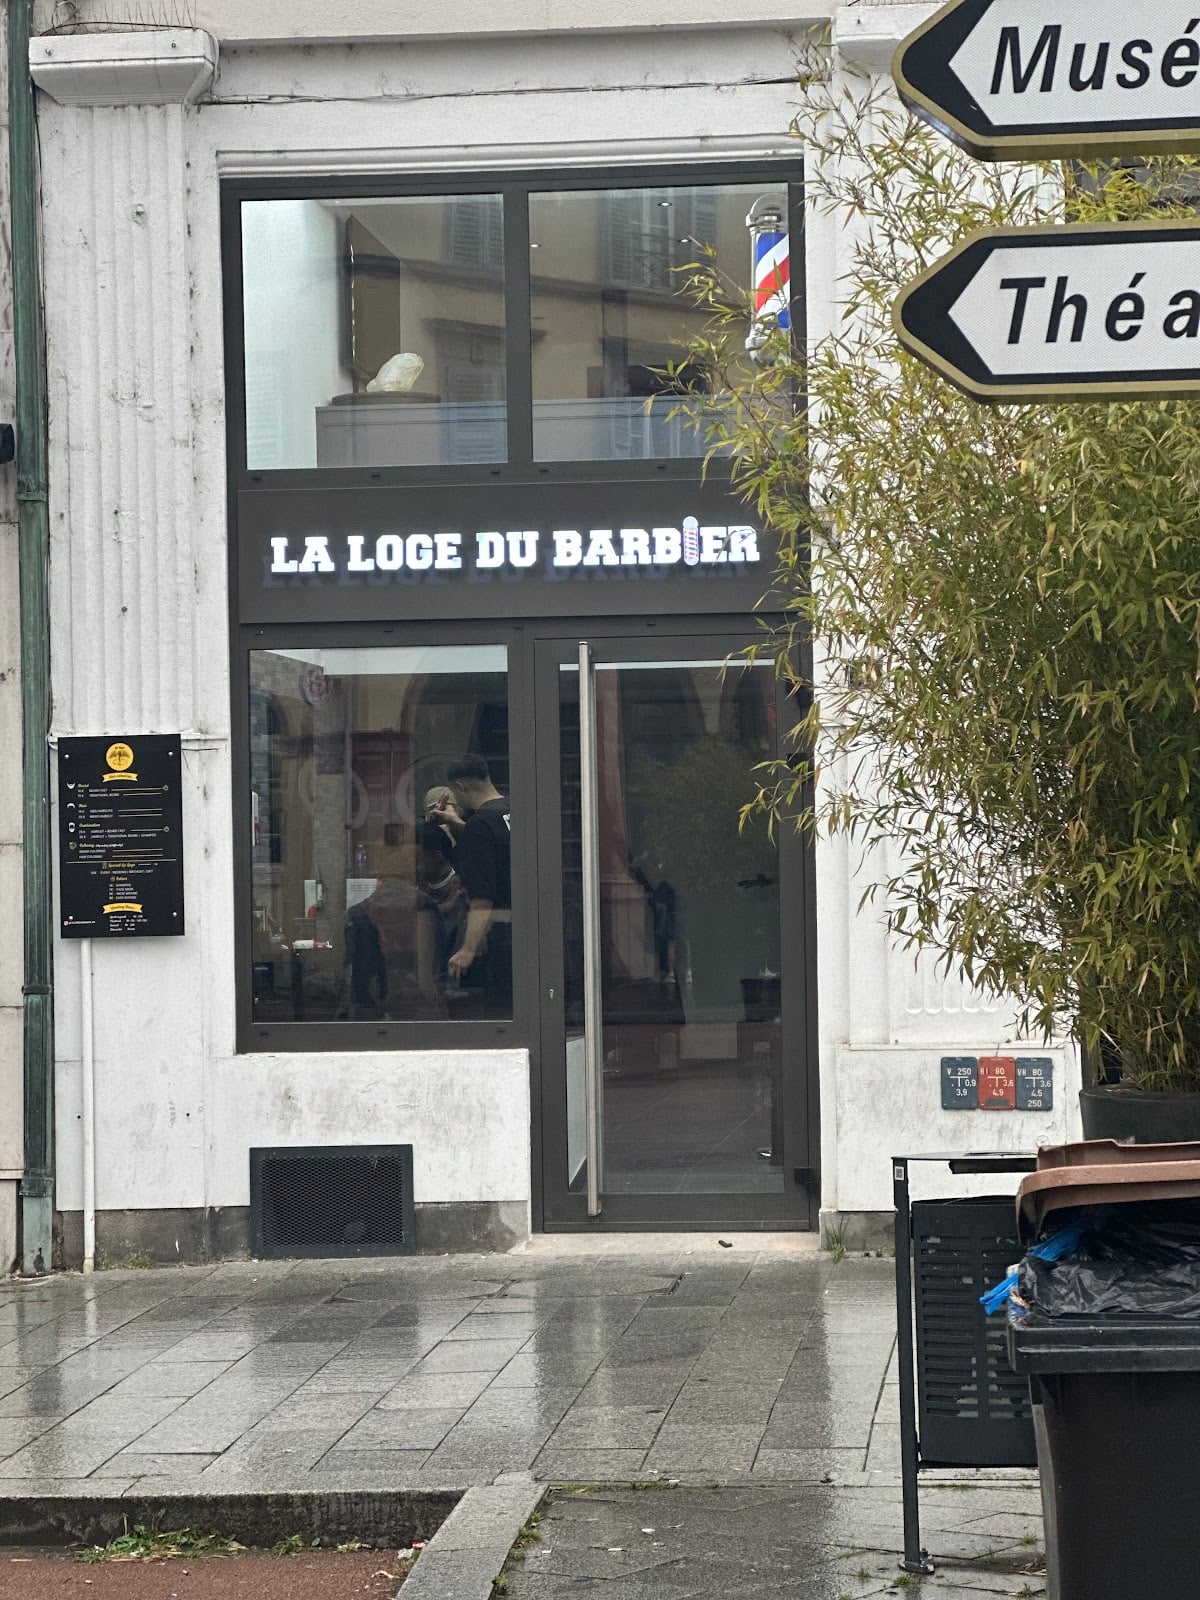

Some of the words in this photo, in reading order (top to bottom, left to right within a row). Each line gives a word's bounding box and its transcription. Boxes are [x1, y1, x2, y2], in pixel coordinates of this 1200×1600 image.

[990, 18, 1200, 95] Musé
[999, 272, 1200, 345] Théa
[270, 536, 335, 573] LA
[347, 533, 462, 572] LOGE
[476, 531, 539, 568] DU
[553, 515, 760, 567] BARBIER
